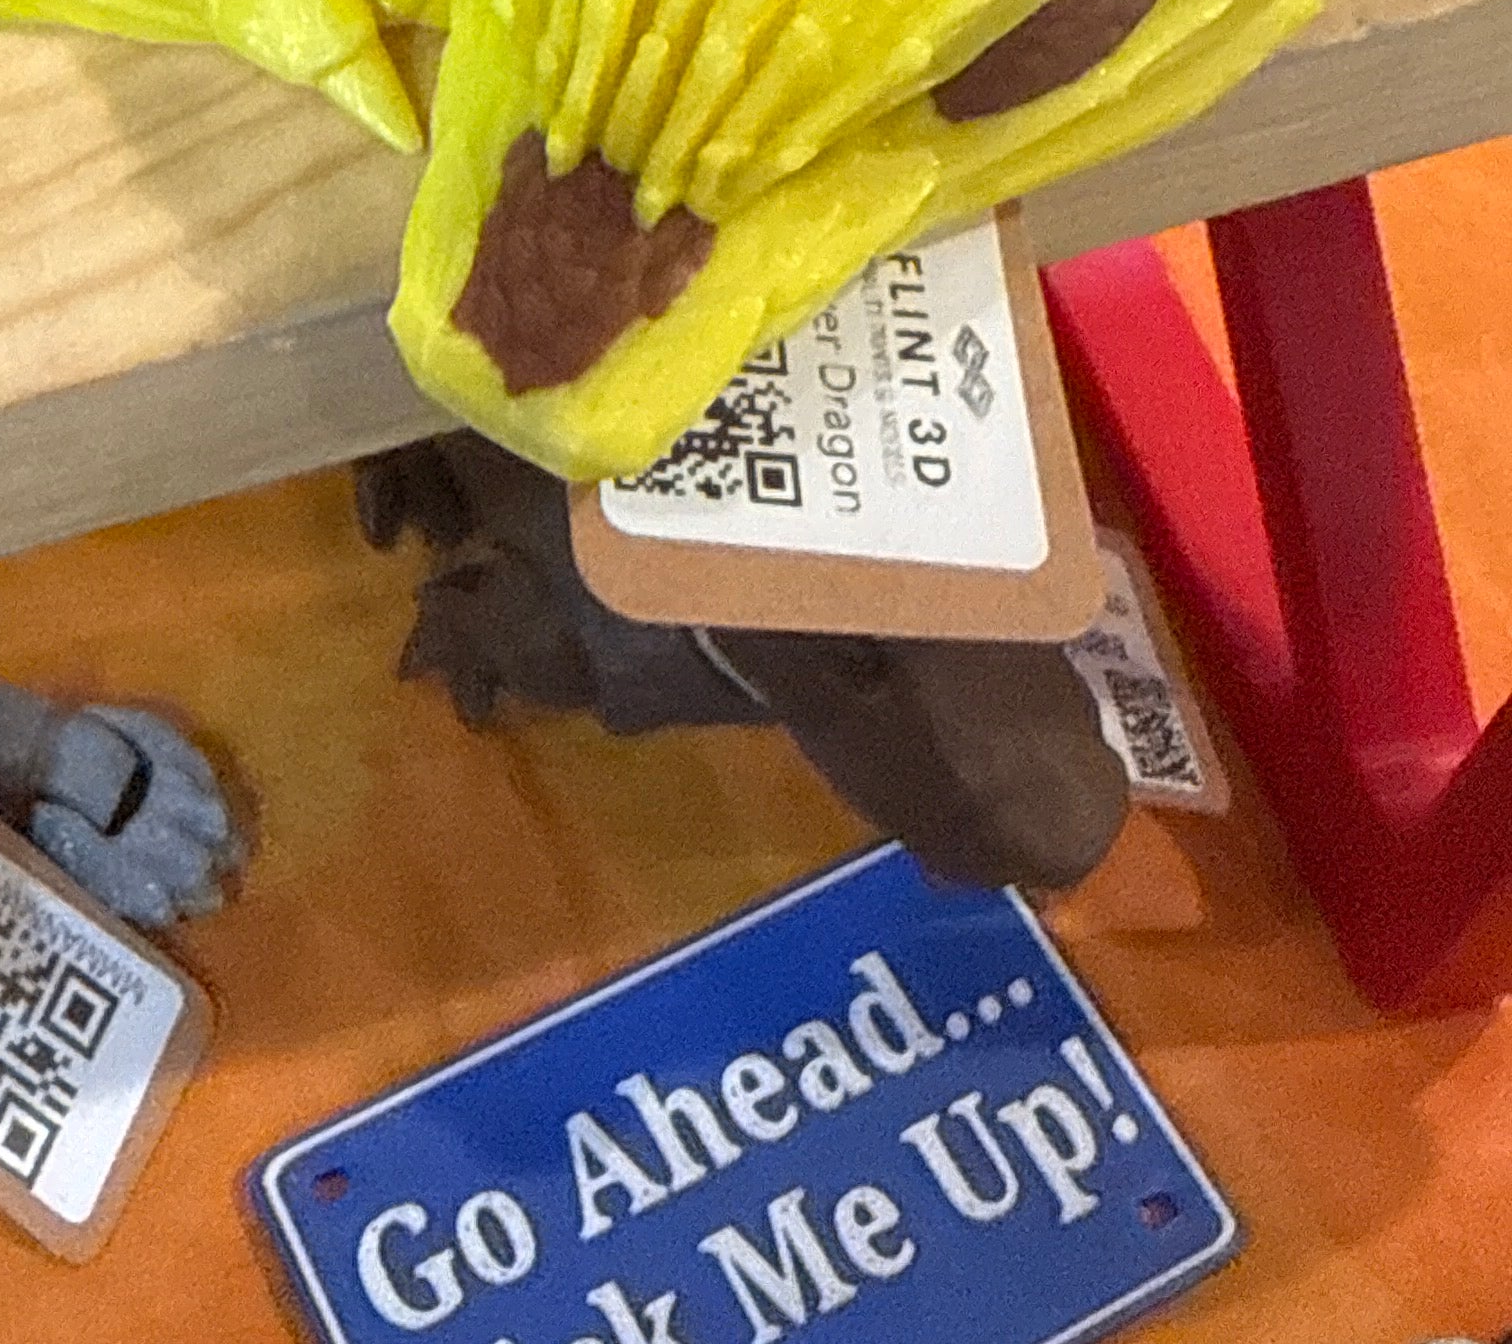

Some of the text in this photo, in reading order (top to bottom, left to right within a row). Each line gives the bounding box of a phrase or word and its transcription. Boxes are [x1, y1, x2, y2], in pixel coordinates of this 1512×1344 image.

[812, 303, 862, 513] er Dragon
[886, 252, 952, 488] FLINT 3D
[357, 950, 1034, 1331] Go Ahead...
[696, 1035, 1139, 1344] Me Up!
